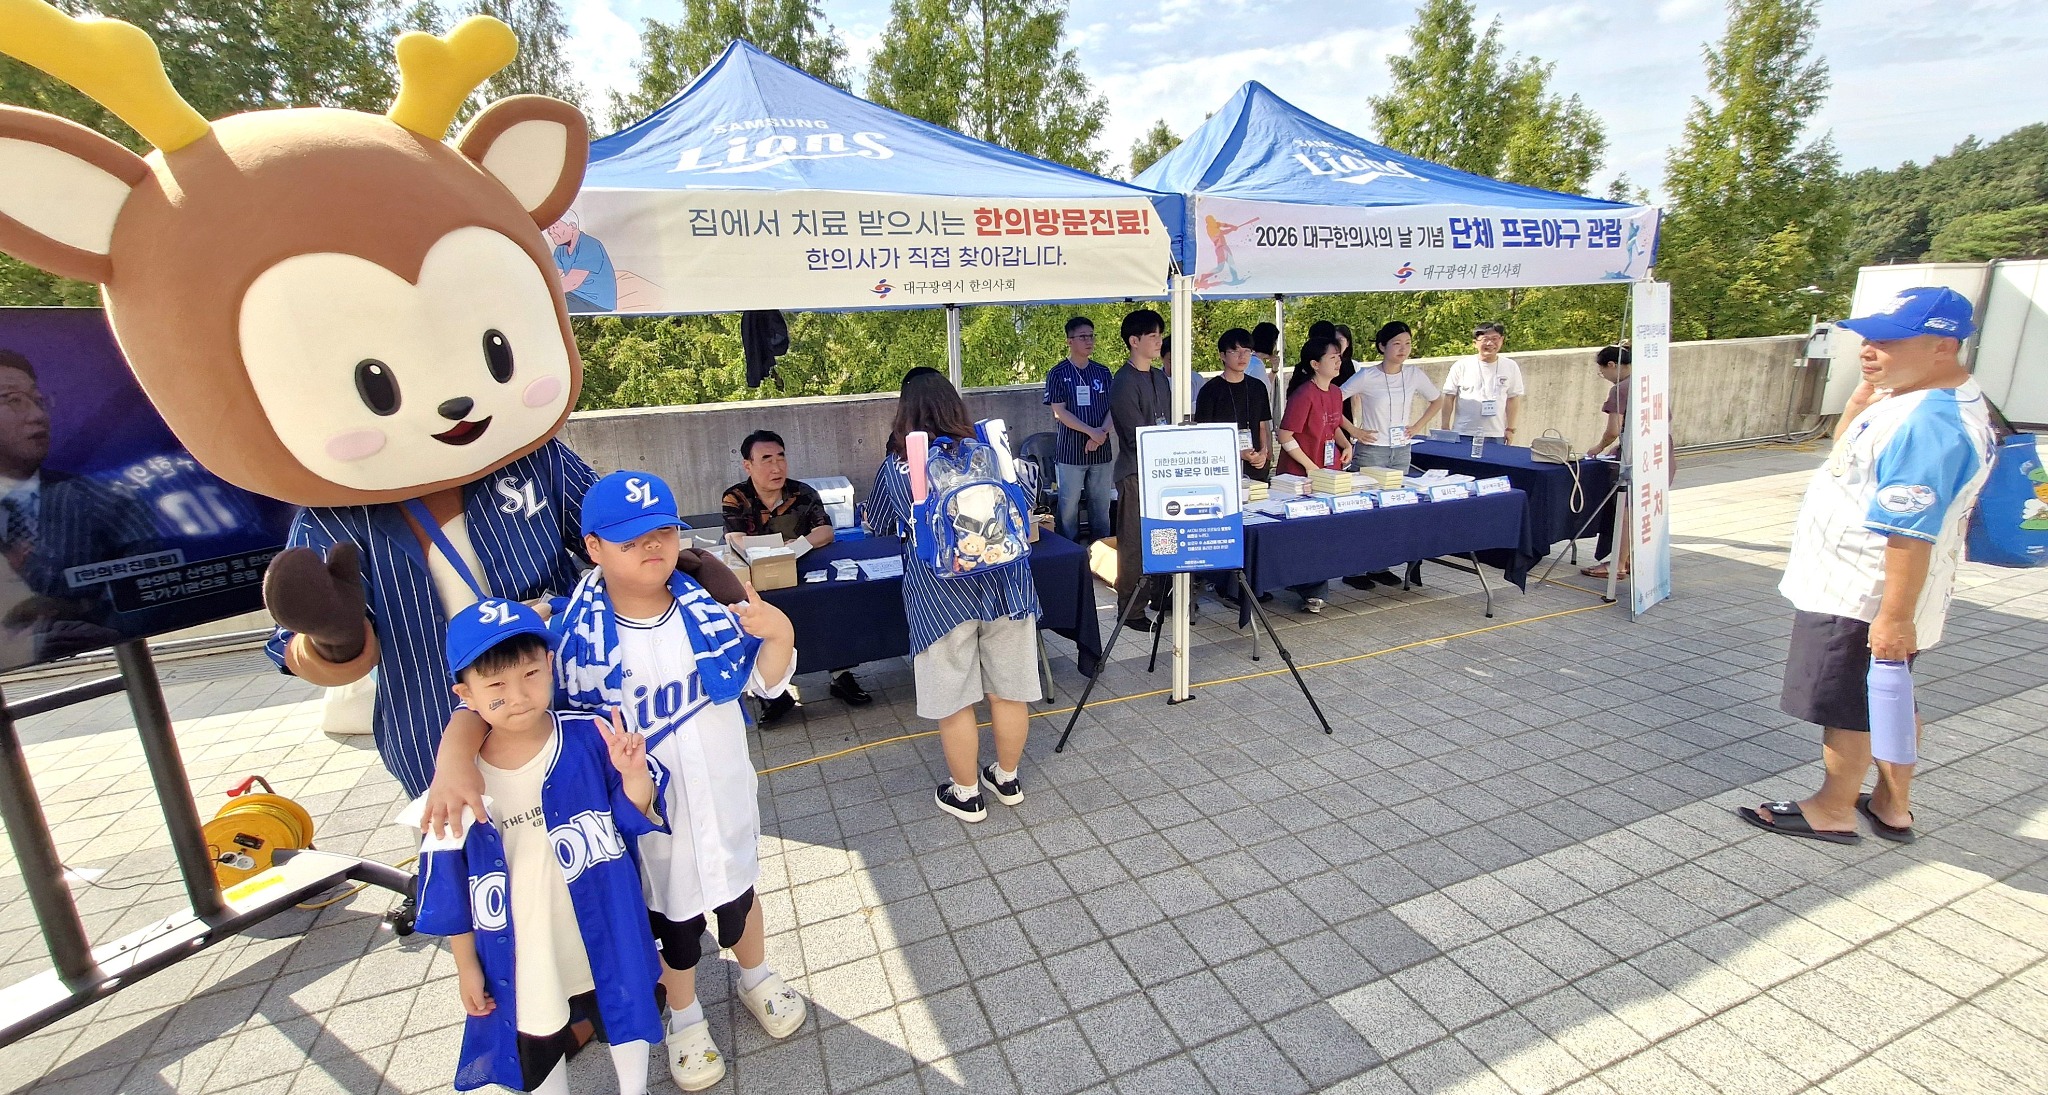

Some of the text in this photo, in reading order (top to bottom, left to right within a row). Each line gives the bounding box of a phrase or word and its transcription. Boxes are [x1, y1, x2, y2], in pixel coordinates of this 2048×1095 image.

[712, 118, 830, 135] SAMSUNG
[667, 129, 895, 175] Lions
[687, 207, 1150, 238] 집에서 치료 받으시는 한의방문진료!
[1255, 217, 1623, 250] 2026 대구한의사의 날 기념 단체 프로야구 관람
[806, 245, 1068, 270] 한의사가 직접 찾아갑니다.
[1423, 262, 1522, 281] 대구광역시 한의사회
[903, 278, 1016, 295] 대구광역시 한의사회
[1093, 378, 1105, 394] SL
[1641, 374, 1651, 437] 티켓
[1152, 466, 1230, 479] SNS 팔로우 이벤트
[1154, 455, 1226, 467] 대한한의사협회 공식
[496, 476, 548, 520] SL
[625, 477, 659, 509] SL
[1641, 482, 1652, 544] 쿠폰
[478, 600, 520, 626] SL
[501, 814, 524, 829] THE
[547, 809, 626, 885] ON
